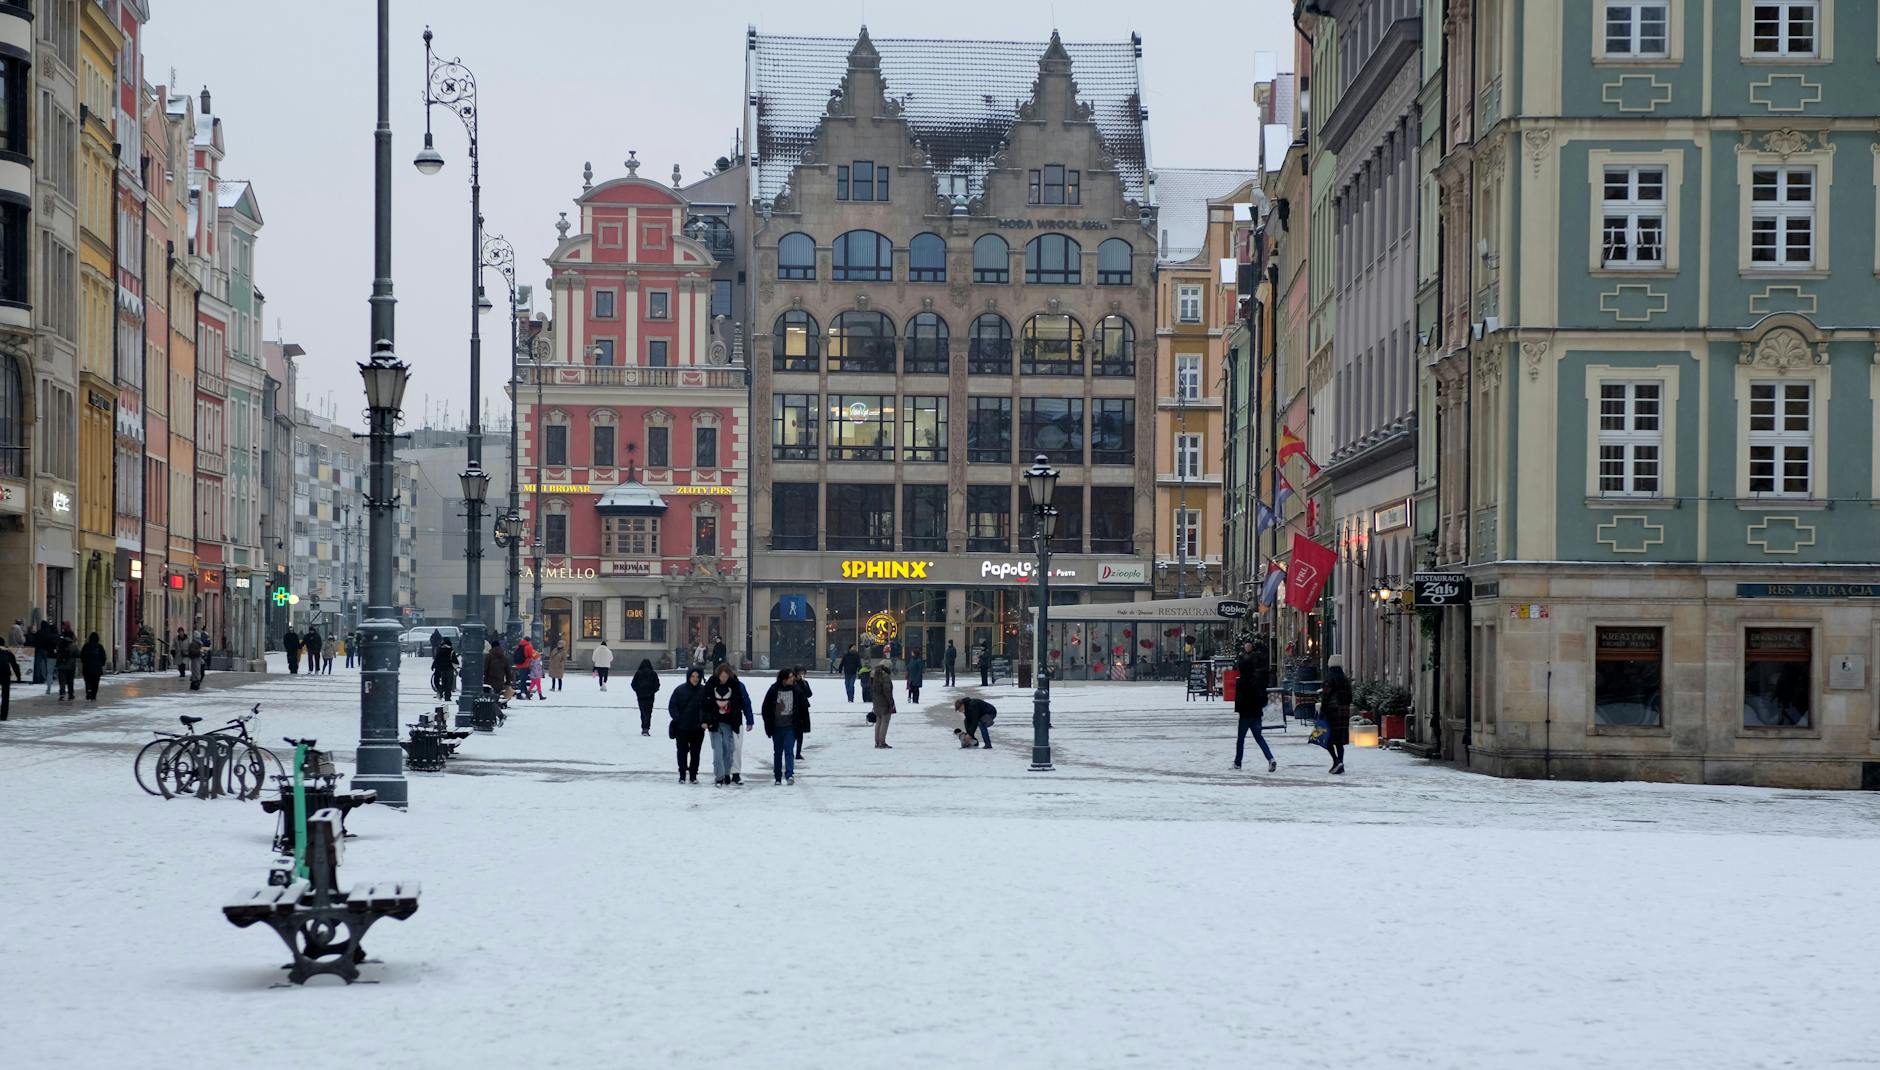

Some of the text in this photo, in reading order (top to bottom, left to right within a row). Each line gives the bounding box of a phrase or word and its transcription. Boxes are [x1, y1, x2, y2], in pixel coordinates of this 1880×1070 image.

[523, 484, 592, 494] MII BROWAR
[710, 486, 733, 495] PIES
[613, 562, 650, 571] BROWAR
[841, 560, 928, 579] SPHINX
[1295, 566, 1309, 583] PRL
[1158, 607, 1217, 617] RESTAURAN
